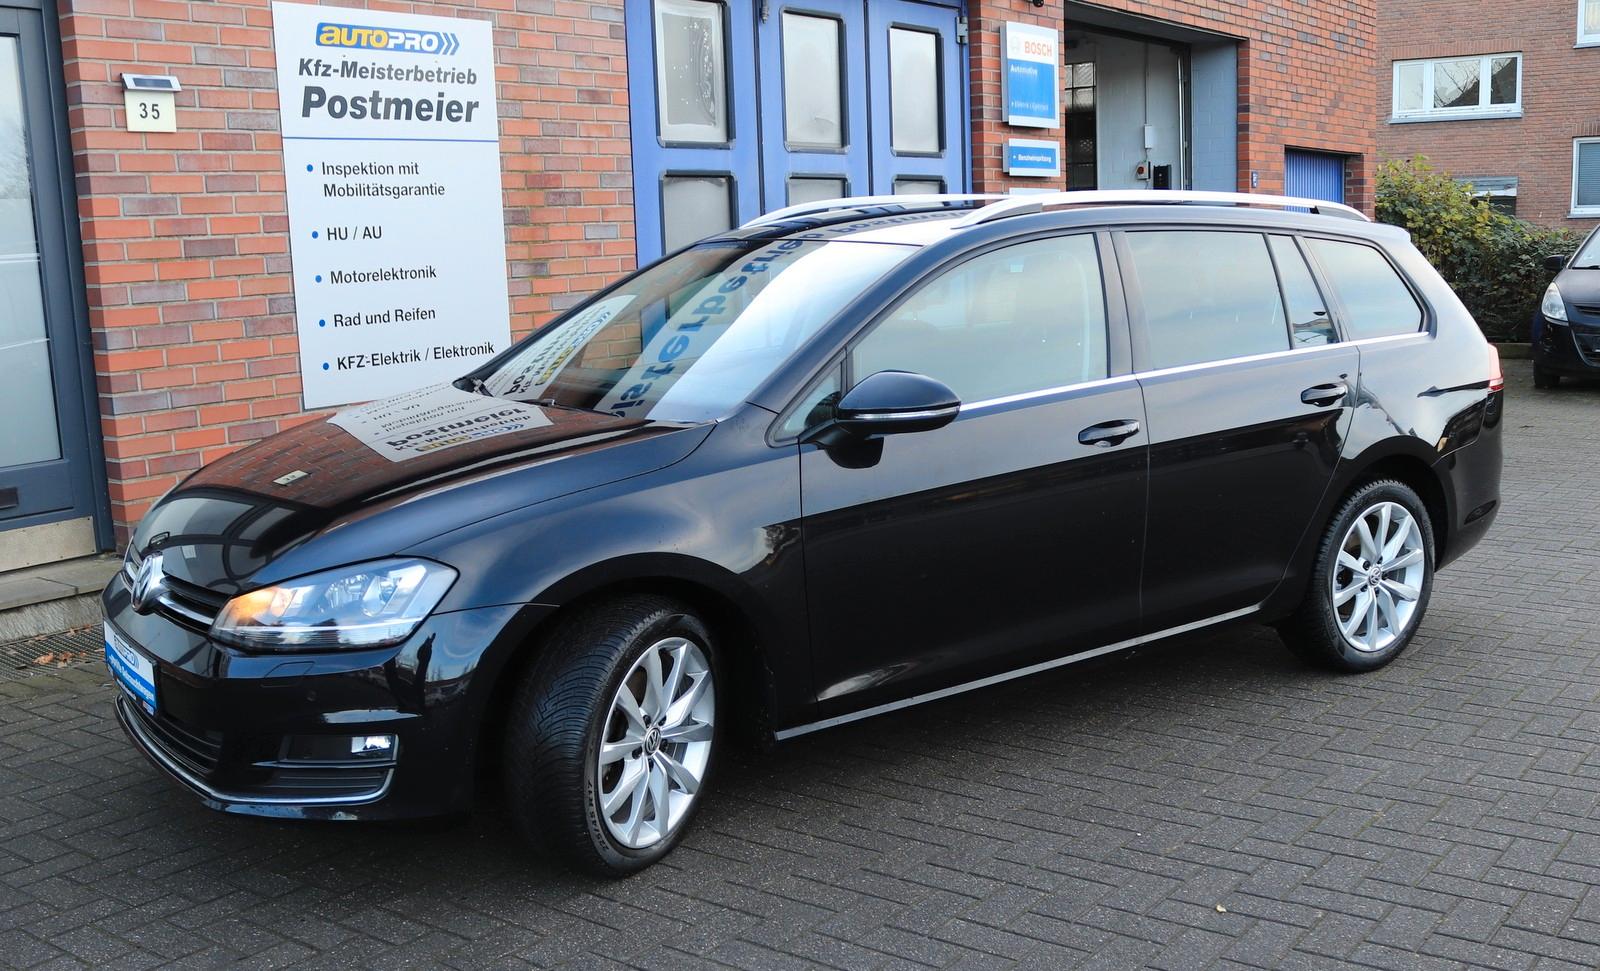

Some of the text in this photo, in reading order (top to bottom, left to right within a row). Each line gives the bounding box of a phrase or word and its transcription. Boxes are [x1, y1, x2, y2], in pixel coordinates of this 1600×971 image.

[1024, 41, 1052, 57] BOSCH
[298, 58, 478, 85] Kfz-Meisterbetrieb
[139, 102, 160, 119] 35
[301, 85, 480, 123] Postmeier
[321, 161, 420, 178] Inspektion mit
[323, 182, 445, 199] Mobilitätsgarantie
[327, 226, 383, 241] HU / AU
[330, 265, 437, 284] Motorelektronik
[333, 307, 436, 328] Rad und Reifen
[337, 341, 496, 371] KFZ-Elektrik / Elektronik
